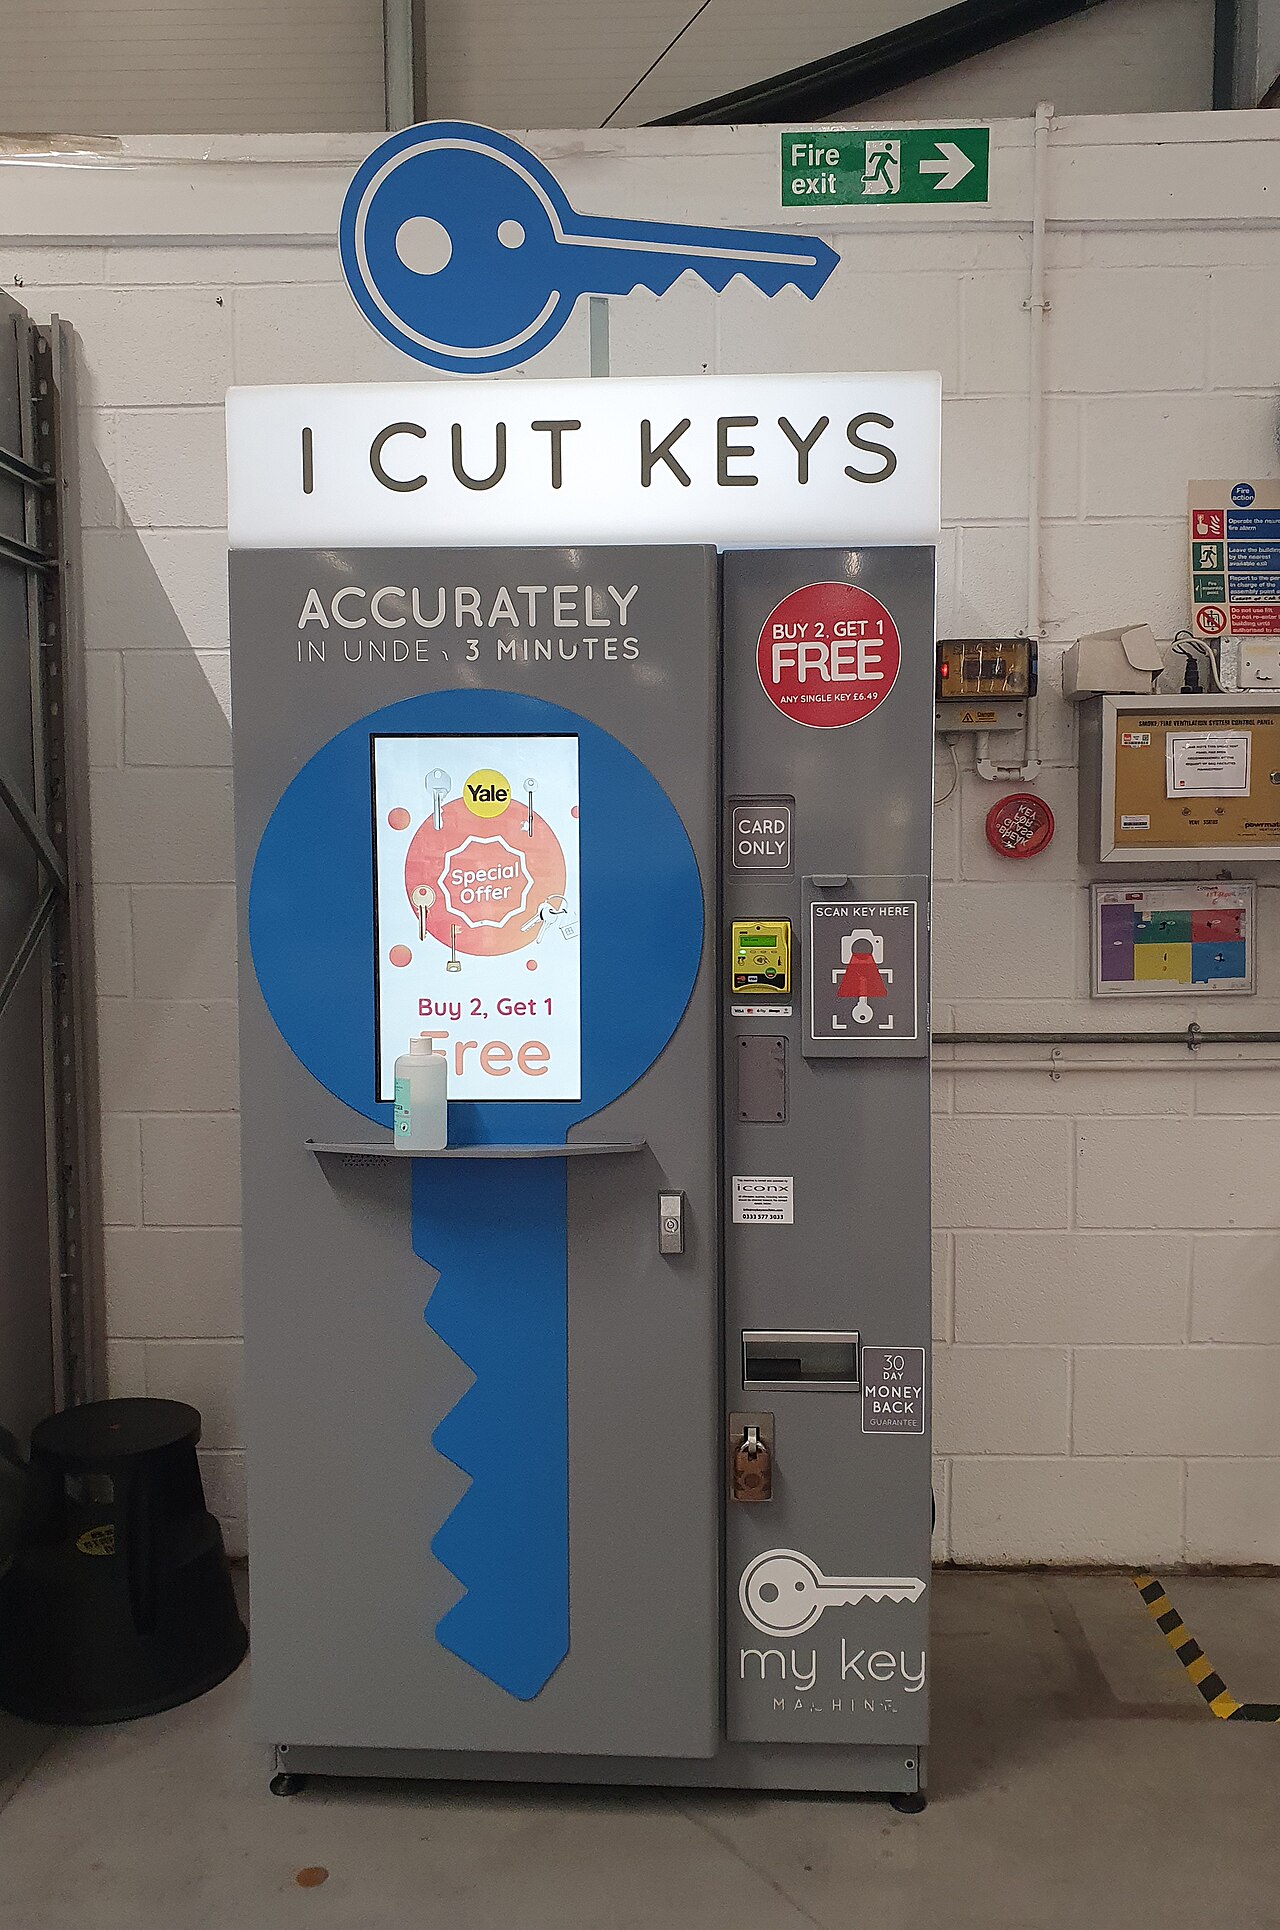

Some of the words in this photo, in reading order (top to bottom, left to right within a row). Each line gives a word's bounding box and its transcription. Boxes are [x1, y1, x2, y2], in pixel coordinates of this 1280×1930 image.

[791, 144, 840, 166] Fire
[791, 172, 837, 195] exit
[301, 427, 314, 494] I
[369, 419, 582, 491] CUT
[641, 412, 898, 487] KEYS
[298, 584, 639, 629] ACCURATELY
[772, 623, 809, 640] BUY
[814, 622, 830, 638] 2,
[833, 620, 869, 637] GET
[876, 619, 884, 635] 1
[298, 640, 326, 662] IN
[466, 638, 480, 661] 3
[497, 636, 640, 660] MINUTES
[772, 638, 885, 684] FREE
[780, 695, 799, 704] ANY
[800, 693, 832, 703] SINGLE
[834, 692, 851, 702] KEY
[853, 692, 878, 701] £6.49
[467, 784, 508, 802] Yale
[738, 819, 785, 834] CARD
[738, 841, 786, 855] ONLY
[451, 862, 519, 887] Special
[460, 885, 511, 904] Offer
[816, 907, 849, 917] SCAN
[853, 907, 876, 917] KEY
[879, 906, 909, 917] HERE
[418, 998, 462, 1021] Buy
[470, 998, 488, 1019] 2,
[496, 997, 537, 1016] Get
[544, 998, 552, 1016] 1
[737, 1184, 789, 1192] iconx
[883, 1354, 905, 1371] 30
[883, 1371, 905, 1381] DAY
[865, 1385, 922, 1399] MONEY
[873, 1401, 914, 1414] BACK
[869, 1418, 918, 1427] GUARANTEE
[740, 1649, 816, 1691] my
[841, 1638, 926, 1692] key
